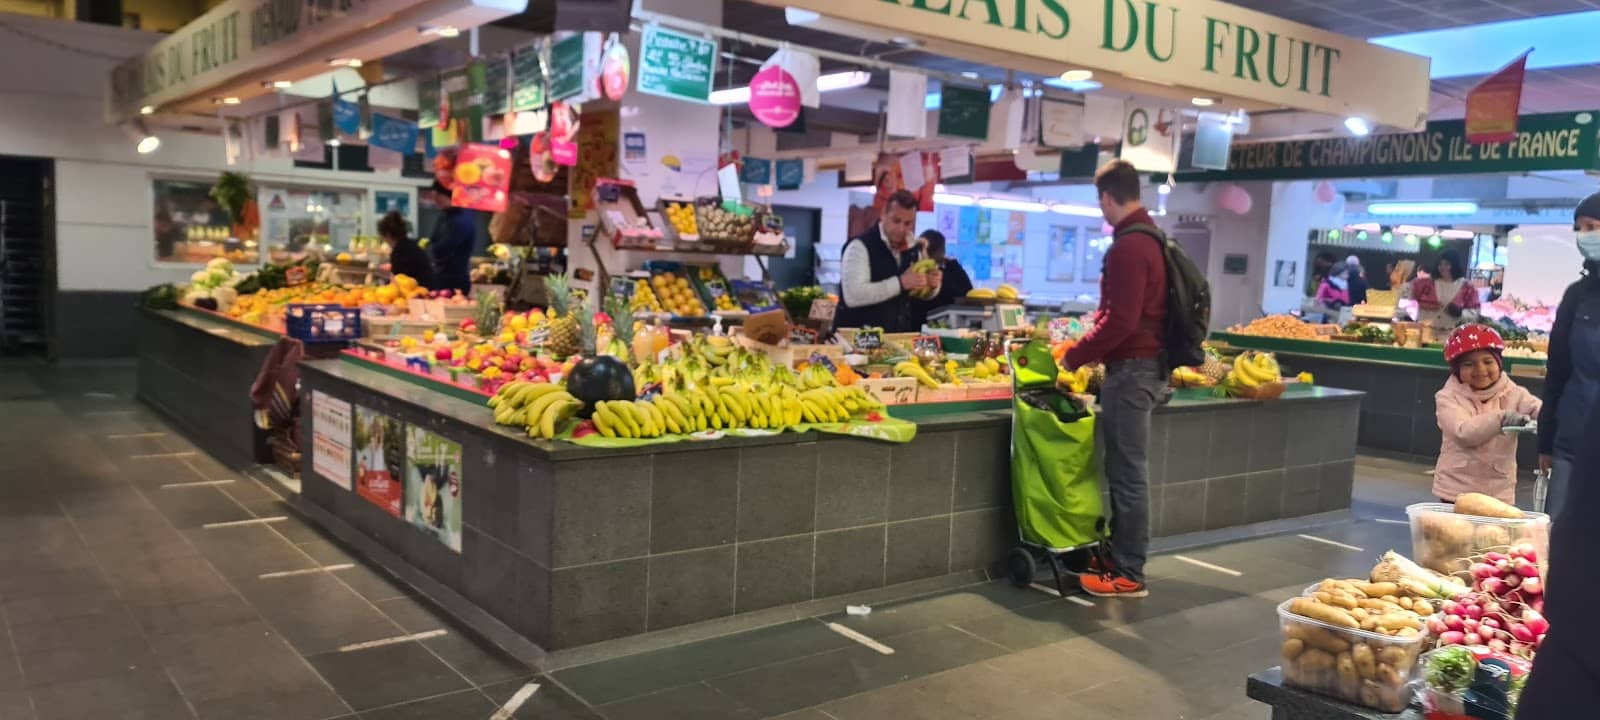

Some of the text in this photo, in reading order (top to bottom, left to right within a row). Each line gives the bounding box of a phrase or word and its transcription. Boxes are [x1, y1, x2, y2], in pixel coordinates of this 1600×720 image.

[1099, 0, 1179, 62] DU
[1202, 16, 1341, 97] FRUIT
[1230, 143, 1276, 169] CTEUR
[1283, 141, 1303, 168] DE
[1309, 131, 1443, 167] CHAMPIGNONS
[1507, 129, 1581, 159] FRANCE
